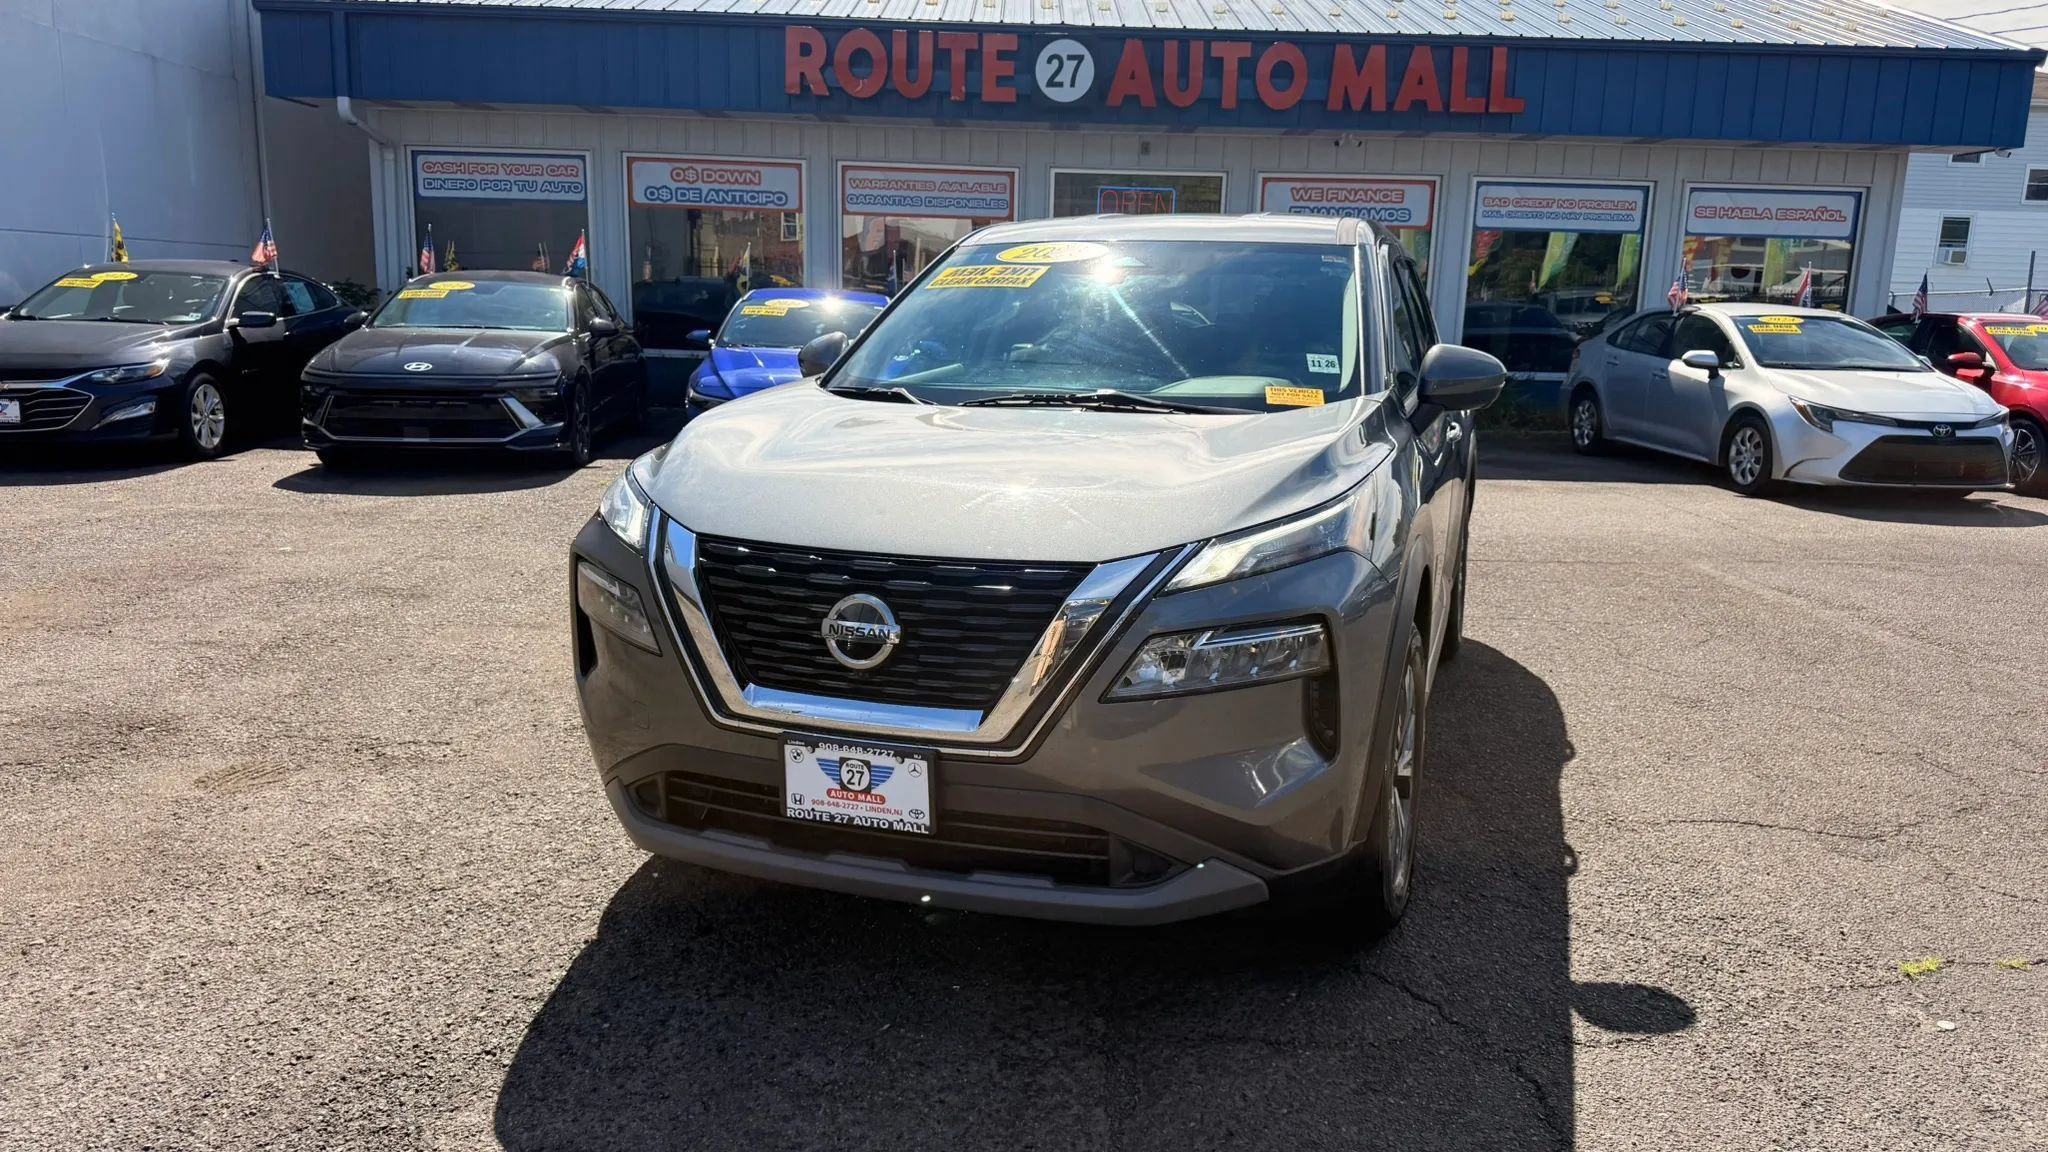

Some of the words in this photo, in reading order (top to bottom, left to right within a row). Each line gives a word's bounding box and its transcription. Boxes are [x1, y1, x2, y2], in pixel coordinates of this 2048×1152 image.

[785, 25, 1018, 103] ROUTE
[1044, 53, 1086, 89] 27
[1106, 38, 1309, 111] AUTO
[1327, 44, 1525, 113] MALL
[422, 161, 466, 174] CASH
[467, 162, 498, 175] FOR
[501, 163, 544, 176] YOUR
[546, 164, 579, 177] CAR
[701, 168, 761, 185] DOWN
[423, 178, 478, 191] DINERO
[480, 179, 513, 192] POR
[515, 180, 538, 192] TU
[540, 181, 583, 194] AUTO
[849, 178, 935, 192] WARRANTIES
[937, 181, 1007, 194] AVAILABLE
[673, 187, 701, 203] DE
[702, 188, 788, 206] ANTICIPO
[847, 194, 922, 207] GARANTIAS
[924, 196, 1008, 209] DISPONIBLES
[1101, 190, 1174, 215] OPEN
[1290, 187, 1323, 201] WE
[1324, 188, 1404, 203] FINANCE
[1483, 197, 1511, 208] BAD
[1512, 198, 1556, 209] CREDIT
[1556, 198, 1577, 210] NO
[1577, 200, 1637, 211] PROBLEM
[1482, 210, 1504, 218] MAL
[1505, 210, 1545, 220] CREDITO
[1545, 211, 1561, 220] NO
[1561, 212, 1582, 221] HAY
[1582, 213, 1634, 222] PROBLEMA
[1695, 206, 1716, 218] SE
[1718, 206, 1772, 220] HABLA
[1775, 206, 1846, 222] ESPAÑOL
[828, 623, 891, 640] NISSAN
[818, 742, 895, 758] 908-648-2727
[846, 770, 865, 787] 27
[811, 798, 859, 811] 908-648-2727
[830, 790, 855, 800] AUTO
[858, 794, 882, 804] MALL
[787, 808, 831, 822] ROUTE
[833, 814, 849, 824] 27
[853, 816, 889, 829] AUTO
[893, 819, 929, 834] MALL
